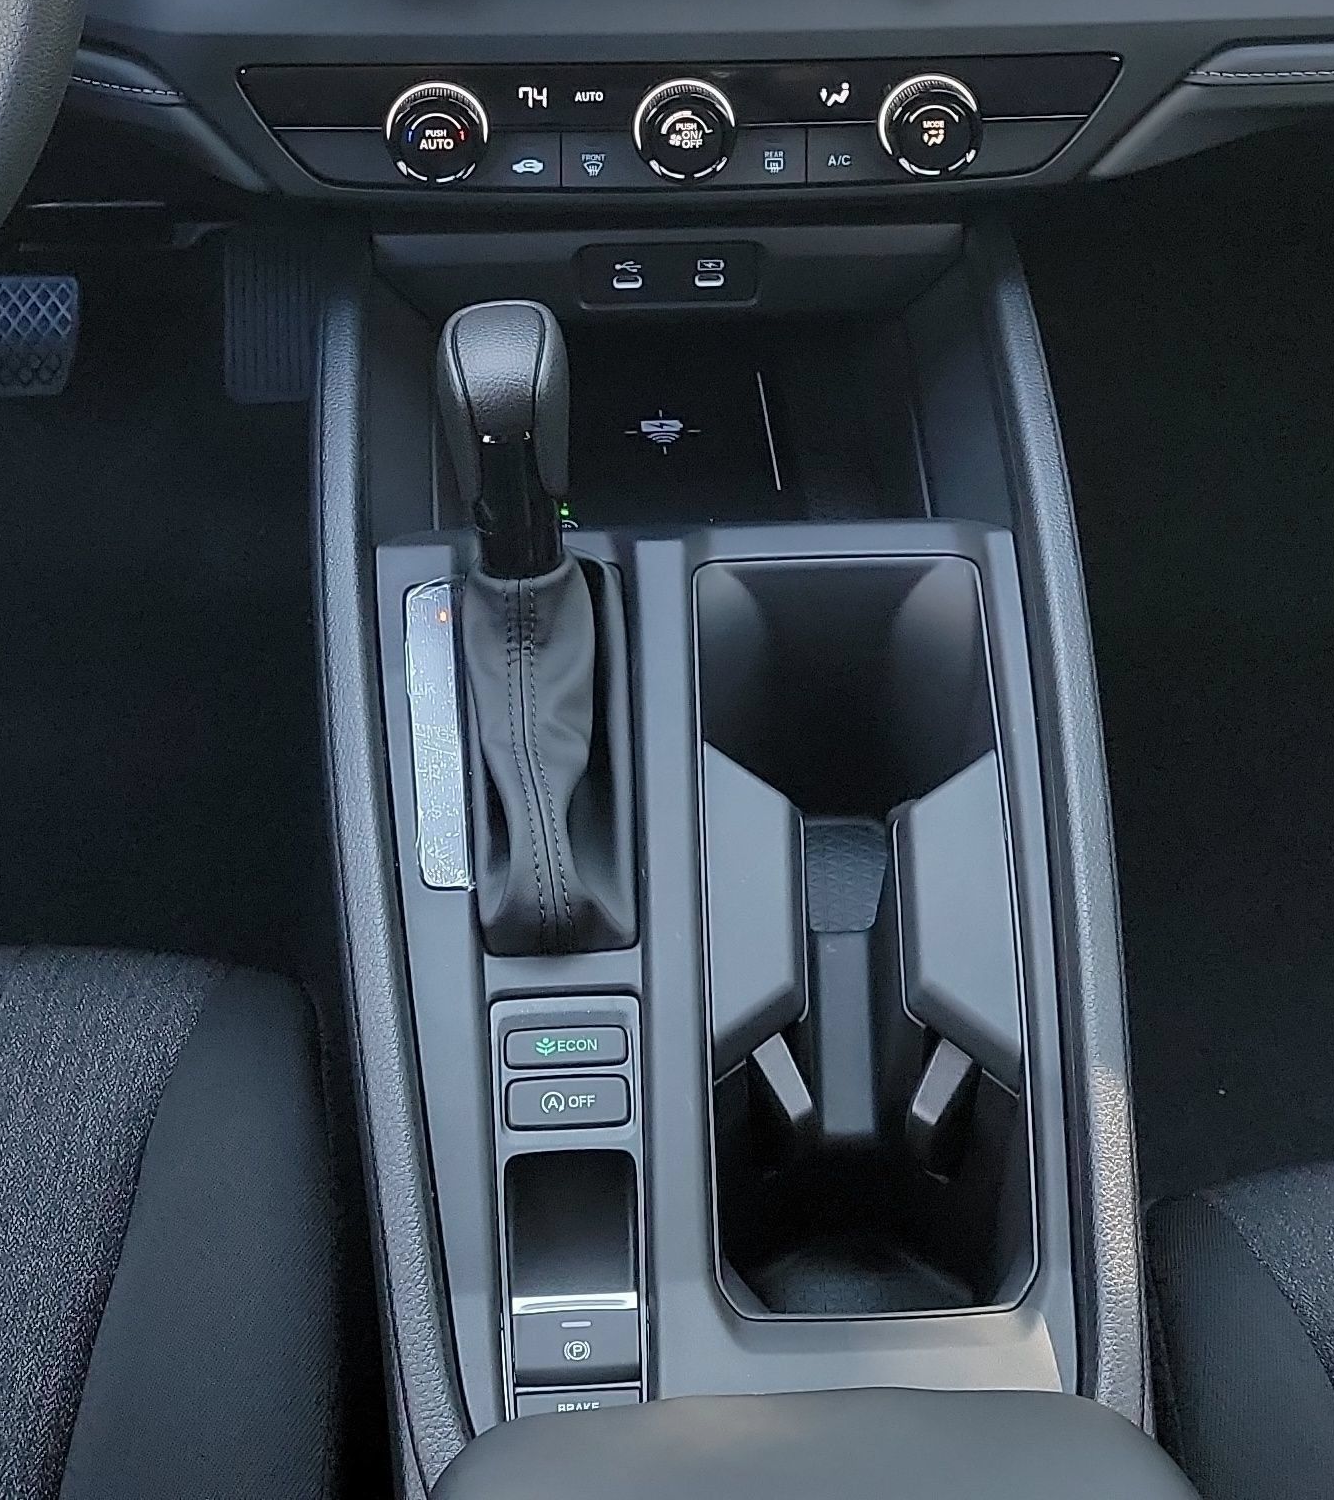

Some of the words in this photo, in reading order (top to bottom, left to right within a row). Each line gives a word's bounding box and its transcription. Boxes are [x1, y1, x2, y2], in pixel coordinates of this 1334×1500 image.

[518, 86, 548, 109] 74
[574, 91, 604, 103] AUTO
[675, 122, 698, 131] PUSH
[424, 129, 447, 138] PUSH
[419, 138, 455, 150] AUTO
[681, 139, 703, 149] OFF
[581, 153, 607, 162] FRONT
[764, 151, 785, 159] REAR
[827, 155, 852, 167] A/C
[557, 1038, 598, 1053] ECON
[567, 1094, 596, 1109] OFF
